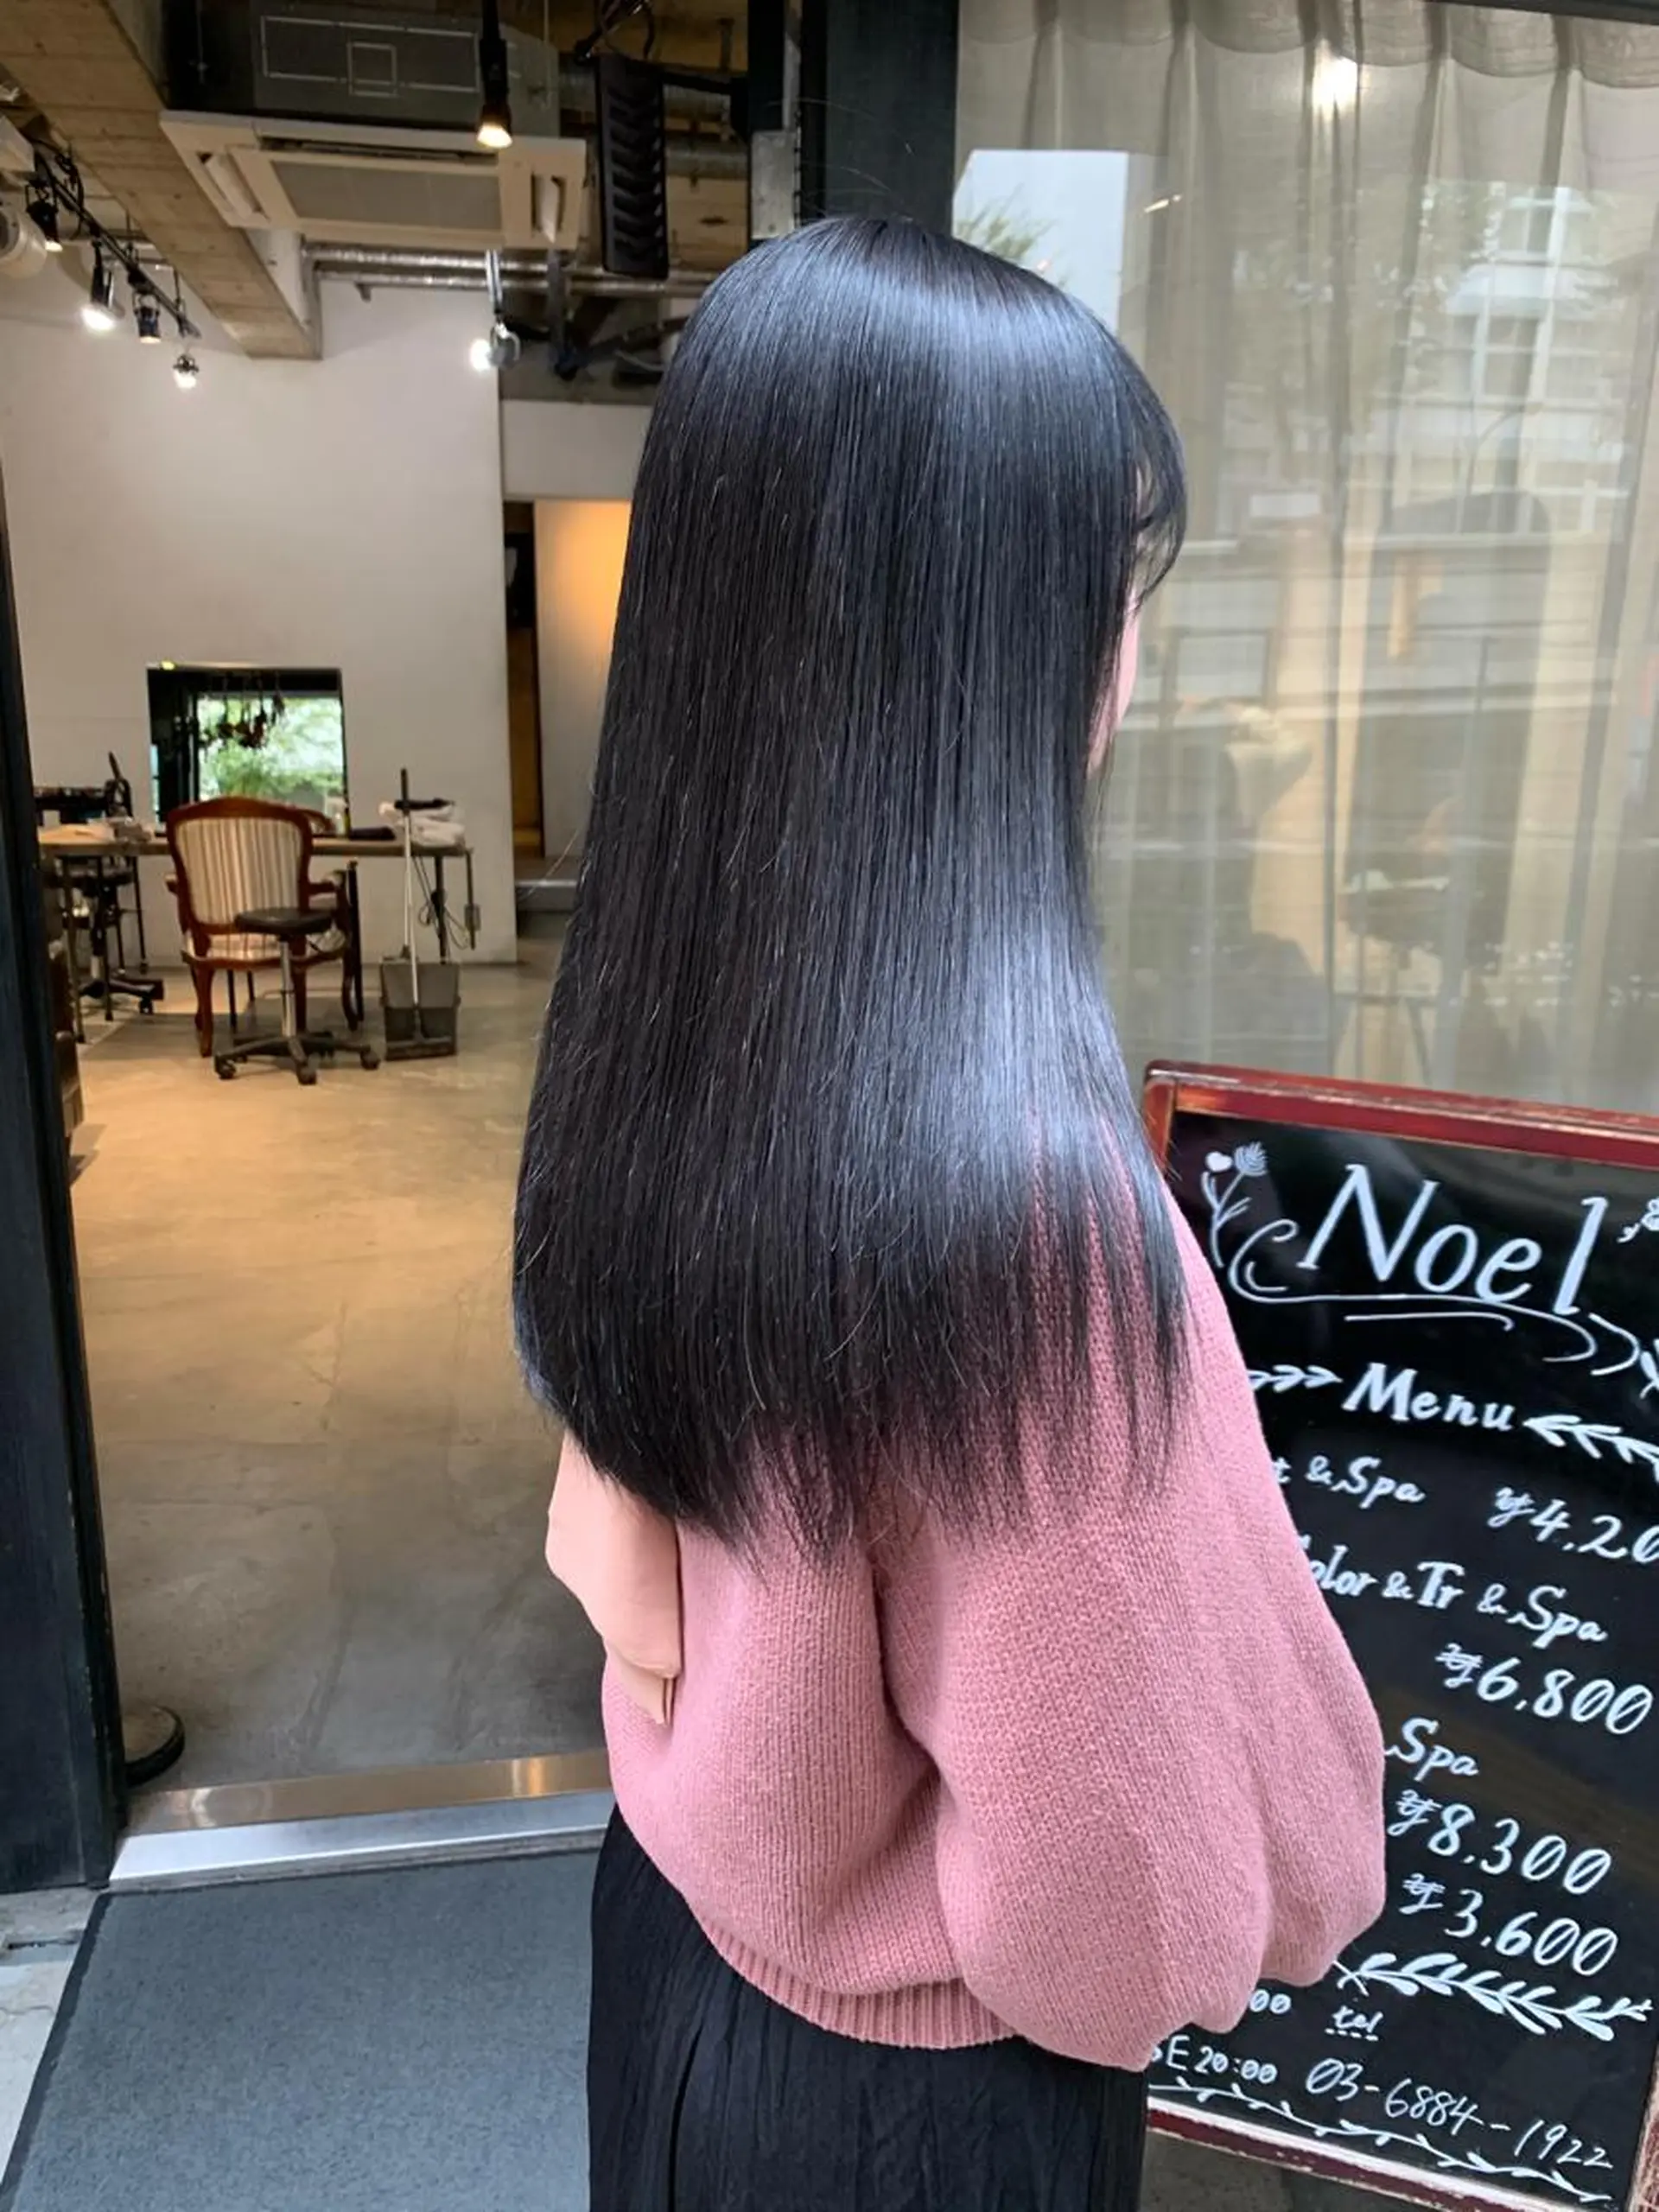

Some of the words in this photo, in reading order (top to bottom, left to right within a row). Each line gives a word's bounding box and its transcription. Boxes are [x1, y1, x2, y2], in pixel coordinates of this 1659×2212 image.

[1295, 1162, 1609, 1316] Noel
[1342, 1362, 1516, 1432] Menu
[1330, 1455, 1427, 1510] Spa
[1298, 1534, 1379, 1597] olor
[1507, 1584, 1609, 1649] Spa
[1383, 1717, 1479, 1782] Spa
[1332, 2005, 1383, 2032] tel
